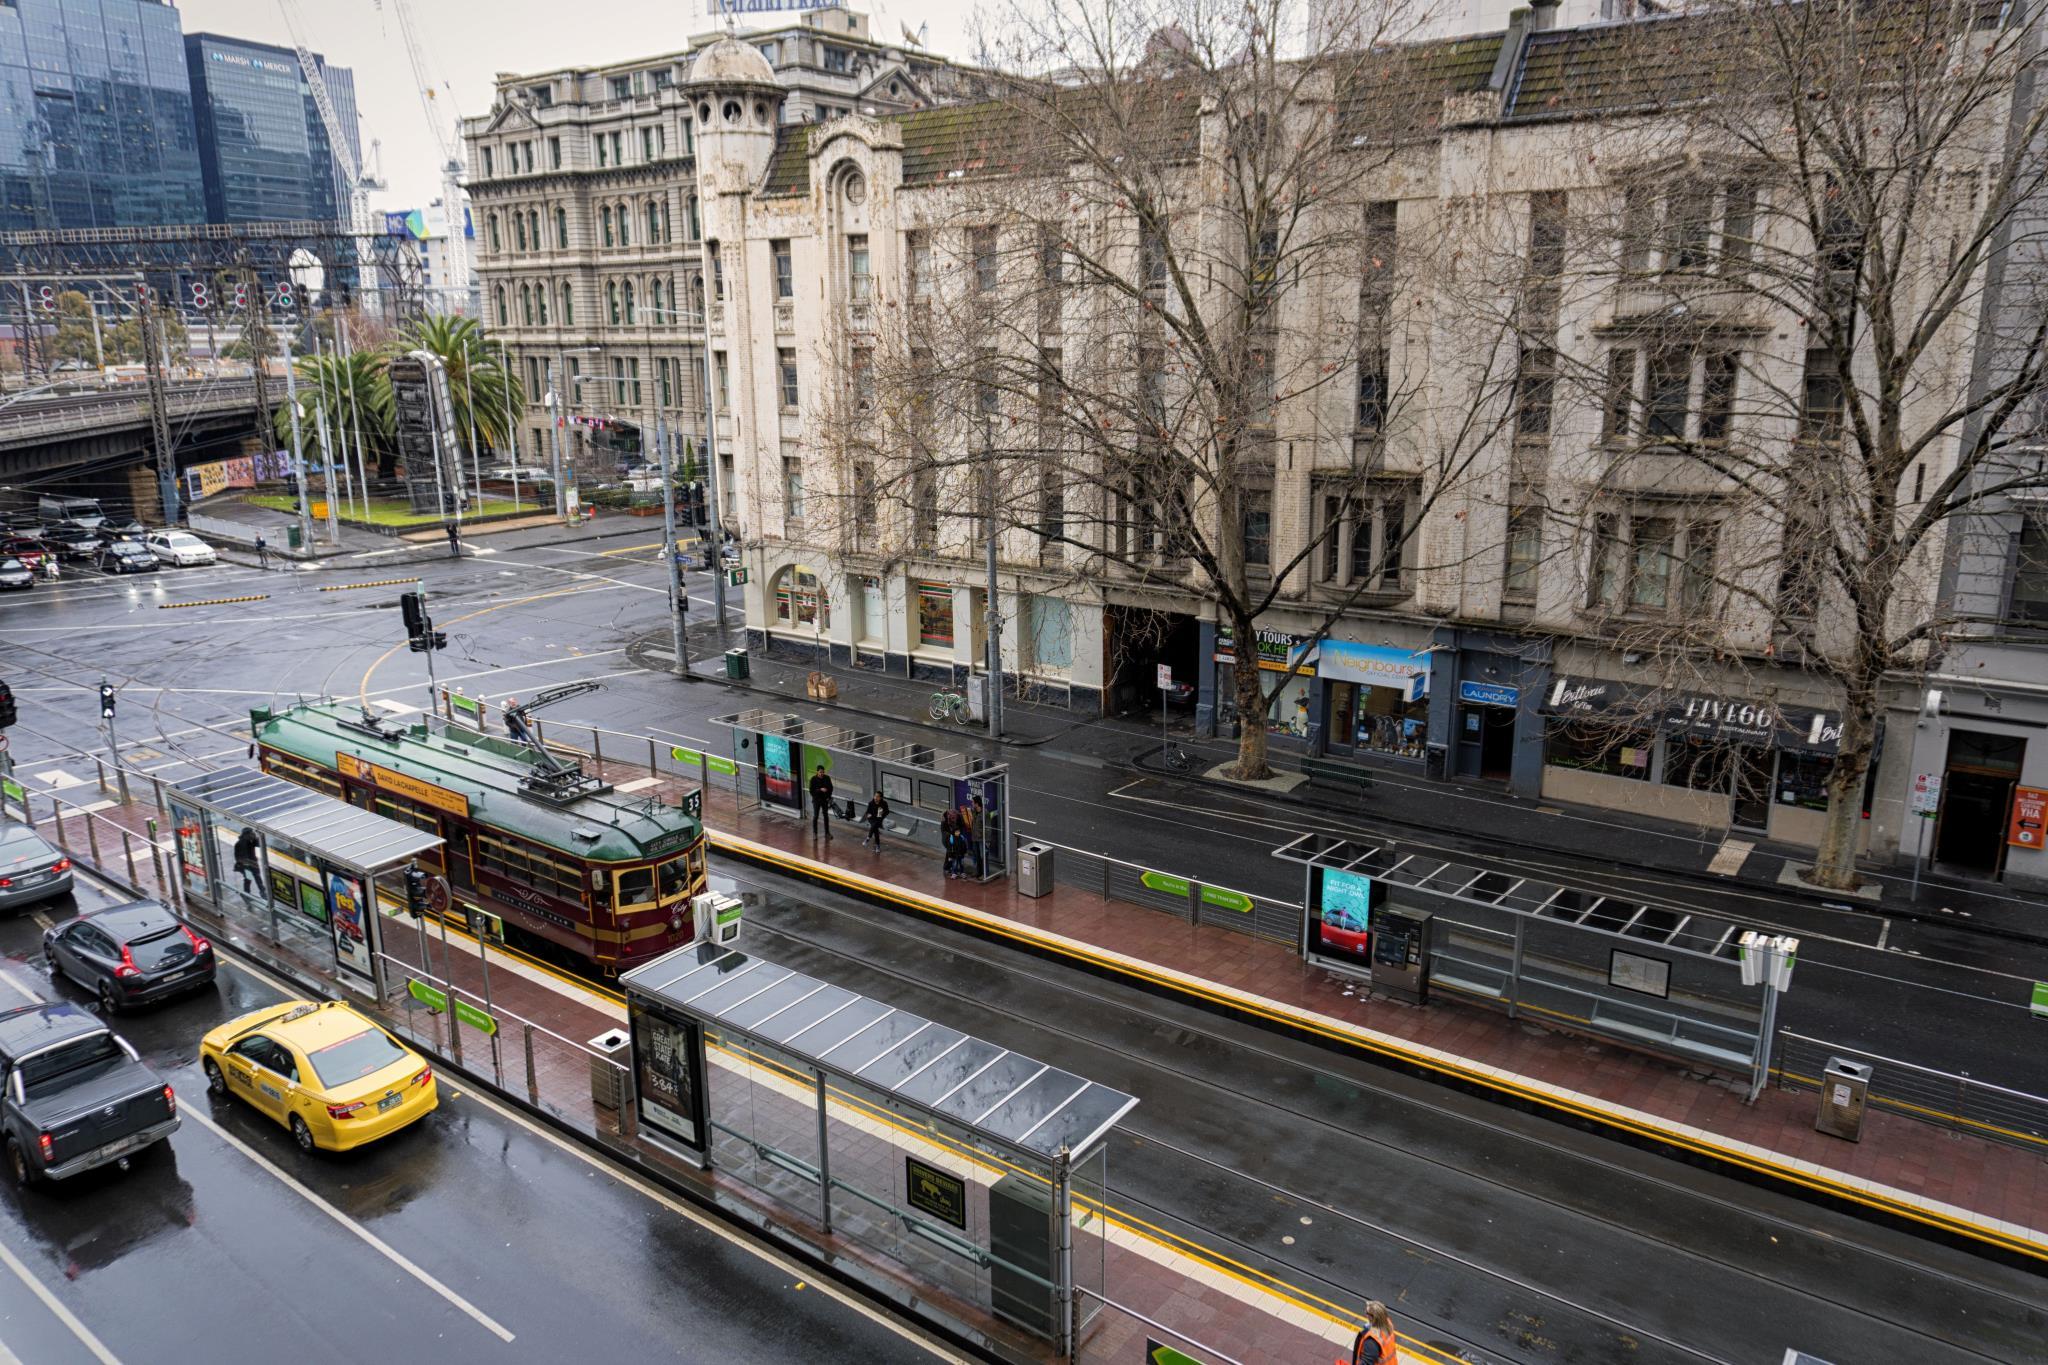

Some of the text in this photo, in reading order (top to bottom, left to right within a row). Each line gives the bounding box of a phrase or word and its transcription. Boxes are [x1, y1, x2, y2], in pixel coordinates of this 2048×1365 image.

[223, 54, 250, 66] MARSH
[263, 62, 291, 73] MERCER
[1263, 631, 1293, 646] TOURS
[1273, 644, 1288, 654] HE
[1333, 648, 1414, 676] Neighbours
[1463, 689, 1516, 705] LAUNDRY
[688, 794, 700, 812] 35
[2020, 807, 2040, 819] YHA
[1326, 885, 1366, 899] NIGHT OWL
[1343, 882, 1356, 890] FOR
[335, 891, 356, 913] fest
[670, 902, 688, 915] City
[652, 1031, 671, 1046] GREAT
[653, 1041, 672, 1057] STATE
[655, 1050, 671, 1065] RATE
